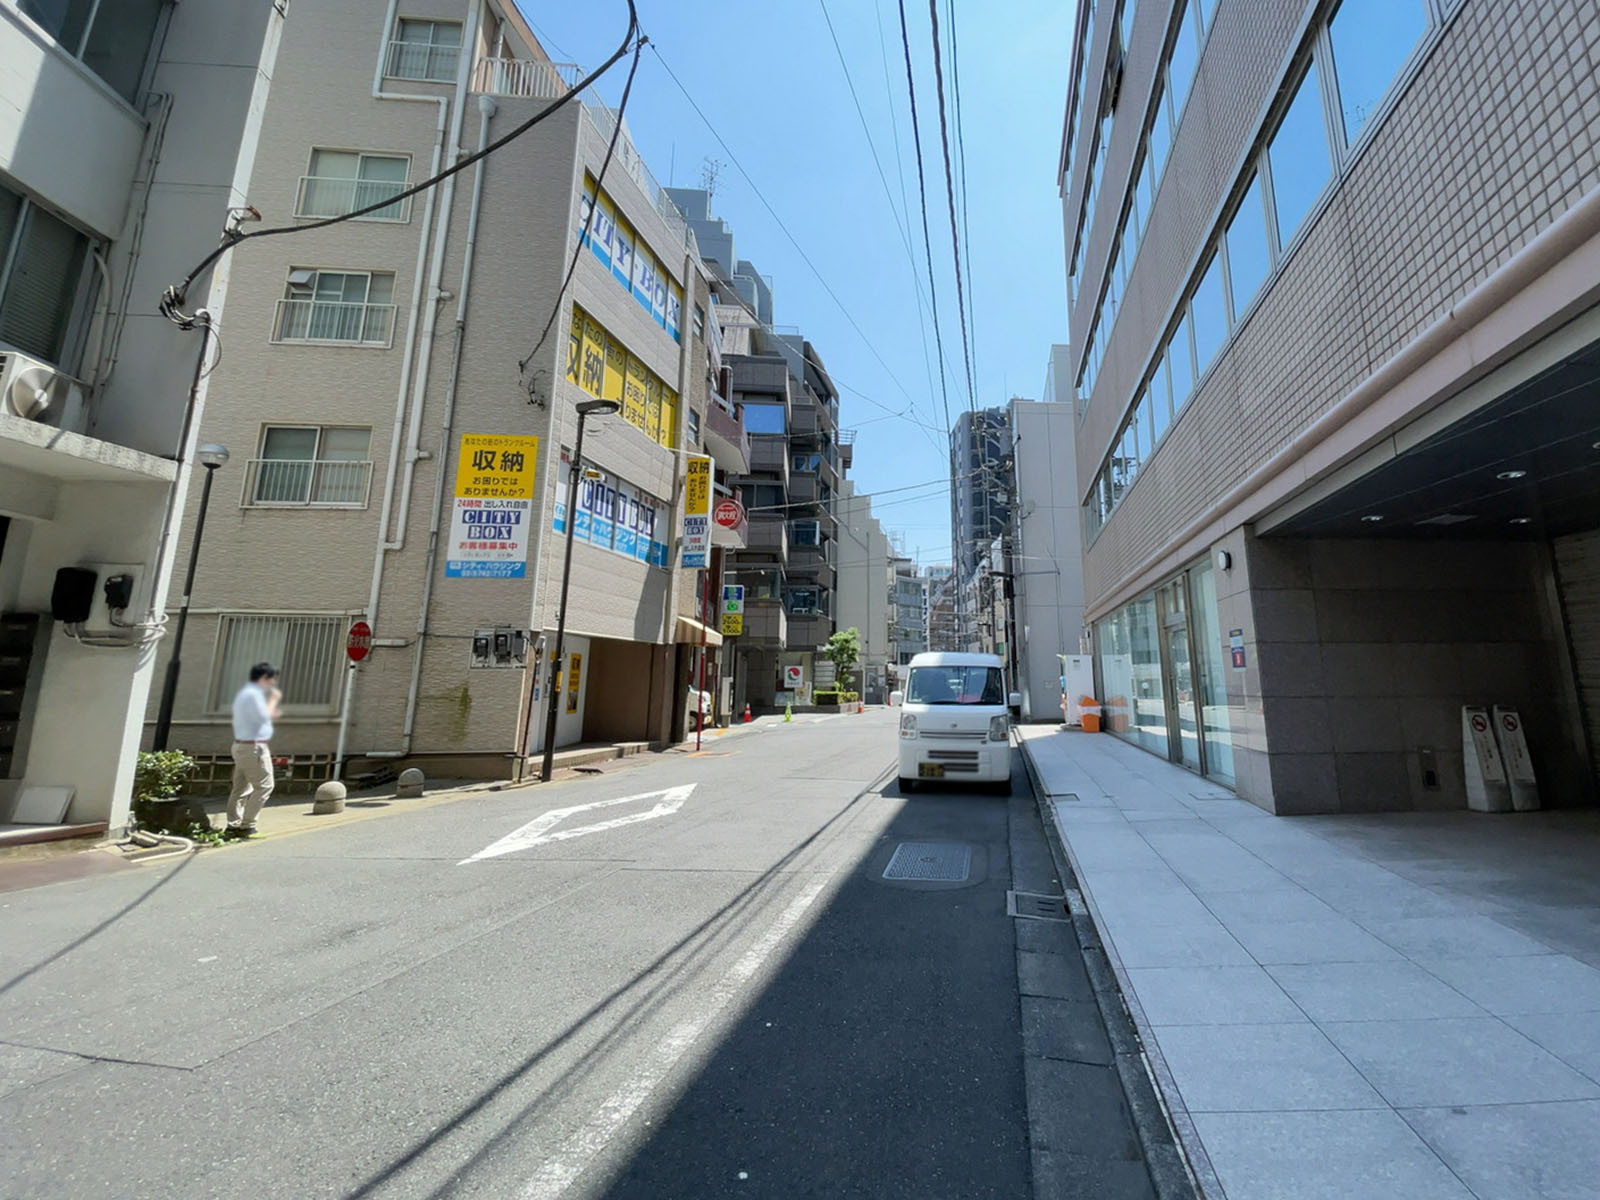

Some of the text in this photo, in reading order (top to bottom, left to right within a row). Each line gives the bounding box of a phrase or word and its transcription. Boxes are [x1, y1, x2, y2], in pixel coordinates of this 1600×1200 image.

[639, 266, 681, 324] BOX
[472, 449, 524, 472] 収納
[472, 476, 519, 486] お困りでは
[464, 487, 526, 497] ありませんか?
[462, 510, 522, 524] CITY
[468, 525, 512, 540] BOX
